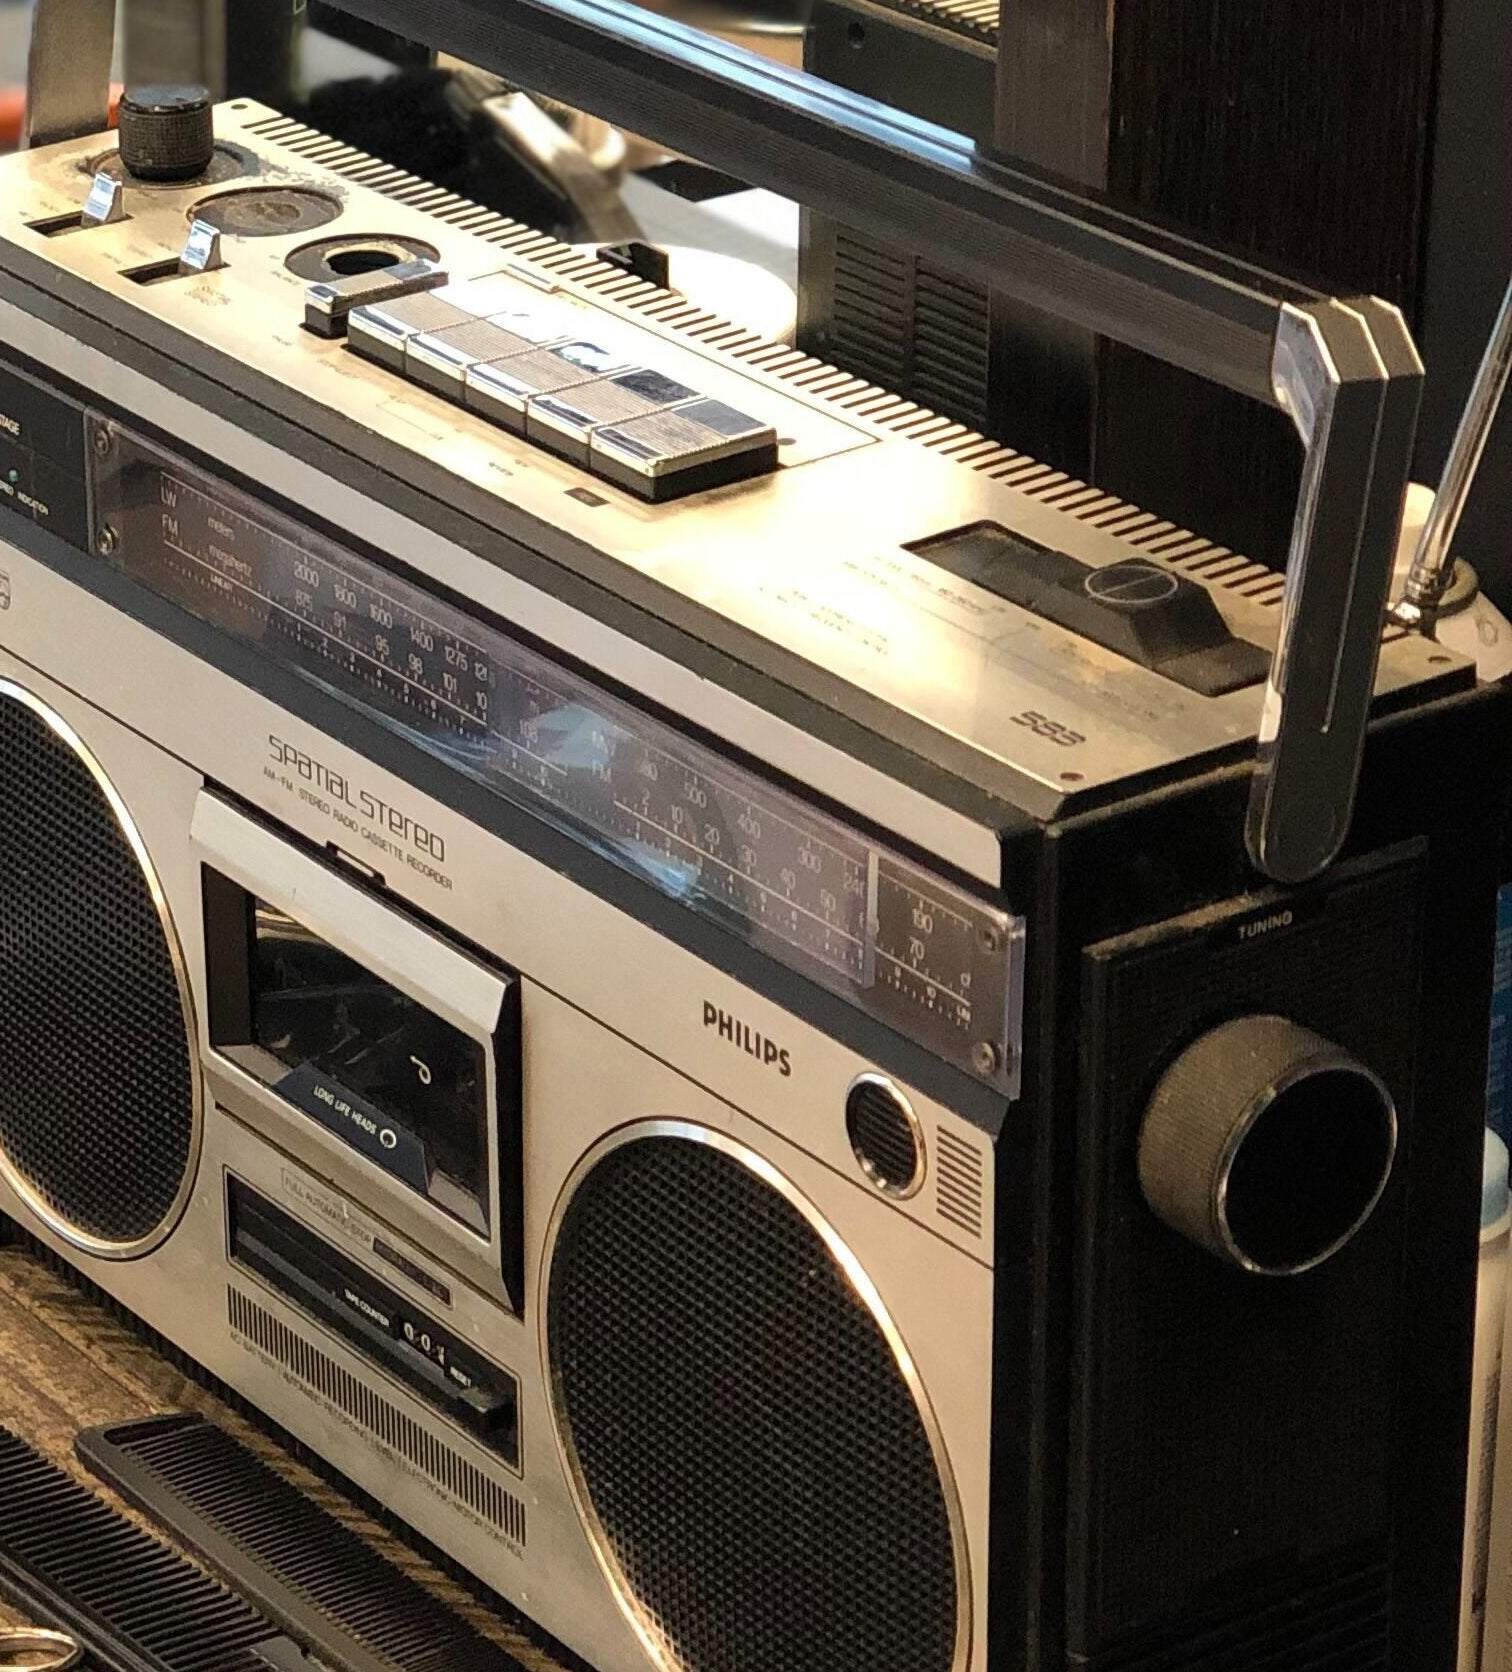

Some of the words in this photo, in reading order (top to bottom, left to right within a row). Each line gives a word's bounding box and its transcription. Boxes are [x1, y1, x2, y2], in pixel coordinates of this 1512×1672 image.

[161, 486, 177, 508] LW
[162, 514, 179, 536] FM
[294, 560, 319, 587] 2000
[410, 626, 433, 651] 1400
[444, 646, 468, 671] 1275
[375, 634, 389, 655] 95
[408, 653, 423, 675] 98
[443, 672, 457, 693] 101
[475, 691, 488, 710] 10
[299, 788, 330, 815] STEREO
[333, 808, 359, 832] RADIO
[361, 827, 404, 861] CASSETTE
[406, 854, 453, 891] RECORDER
[738, 813, 760, 839] 400
[798, 846, 821, 873] 300
[912, 908, 933, 934] 190
[704, 823, 720, 845] 20
[909, 936, 924, 960] 70
[703, 999, 791, 1077] PHILIPS
[313, 1085, 335, 1106] LONG
[334, 1100, 351, 1117] LIFE
[351, 1110, 377, 1135] HEADS
